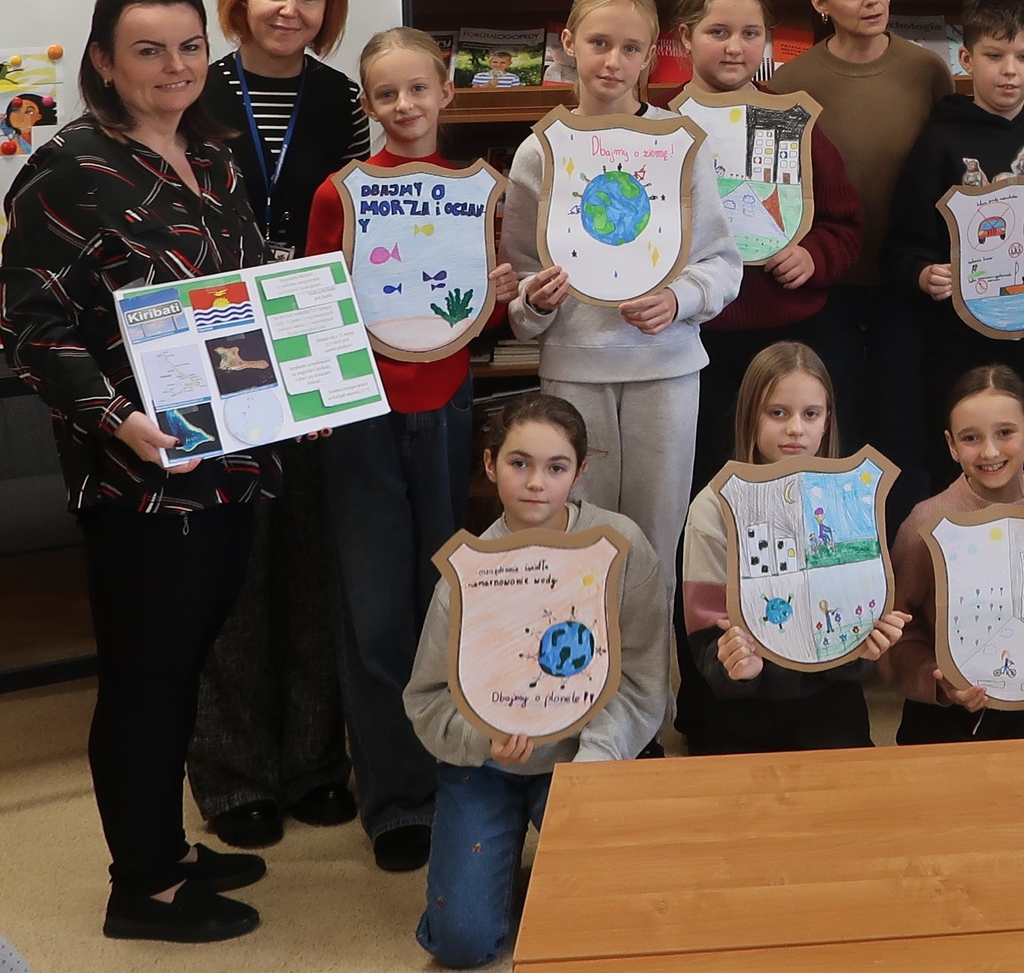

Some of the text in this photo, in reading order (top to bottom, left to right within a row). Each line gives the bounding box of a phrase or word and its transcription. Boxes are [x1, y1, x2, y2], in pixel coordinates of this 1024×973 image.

[591, 135, 629, 163] Dbajmy
[361, 182, 446, 200] DBAJMY O
[360, 200, 430, 216] MORZA
[435, 201, 441, 216] i
[358, 218, 371, 233] Y
[126, 302, 181, 324] Kiribati
[534, 574, 558, 589] wody
[492, 691, 528, 708] Dbajmy
